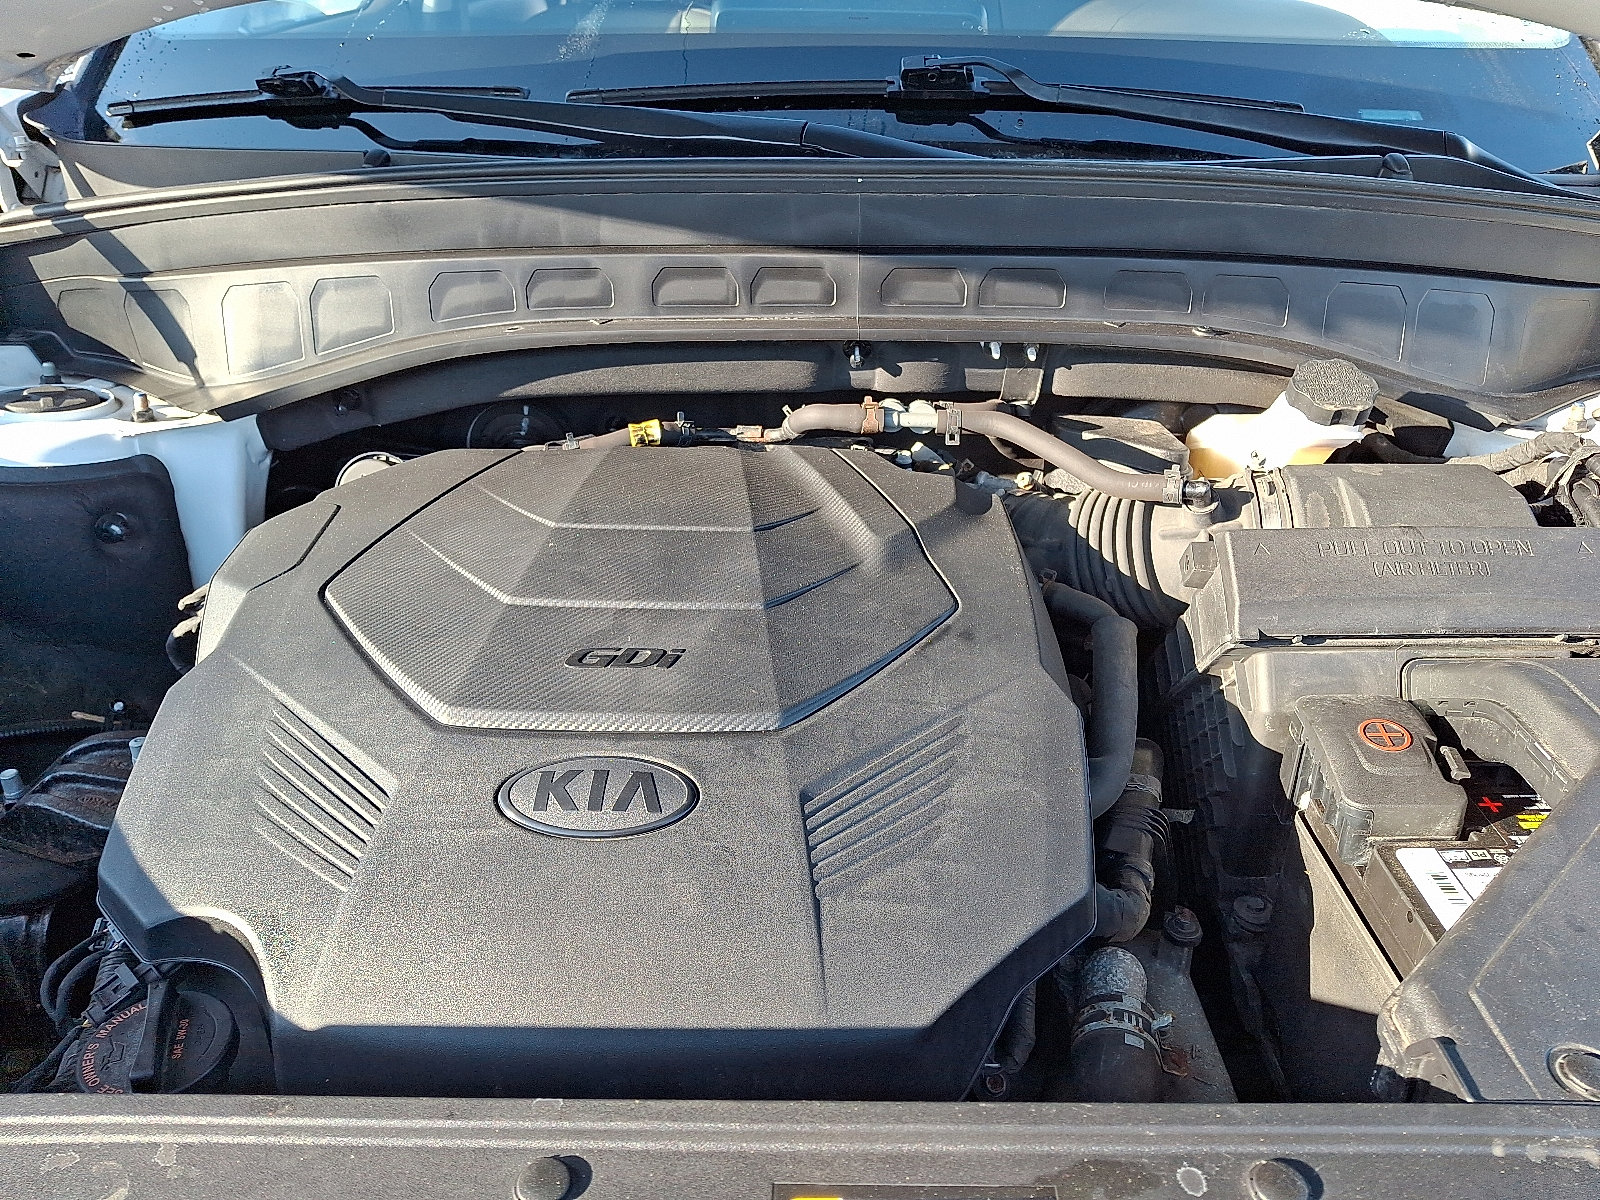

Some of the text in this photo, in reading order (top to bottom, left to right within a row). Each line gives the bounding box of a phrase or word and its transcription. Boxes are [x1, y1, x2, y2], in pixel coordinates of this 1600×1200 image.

[1317, 540, 1535, 557] PULL OUT TO OPEN
[533, 769, 662, 814] KIA
[82, 1043, 100, 1087] OWNER'S
[96, 1003, 148, 1039] MANUAL
[171, 1043, 184, 1059] SAE
